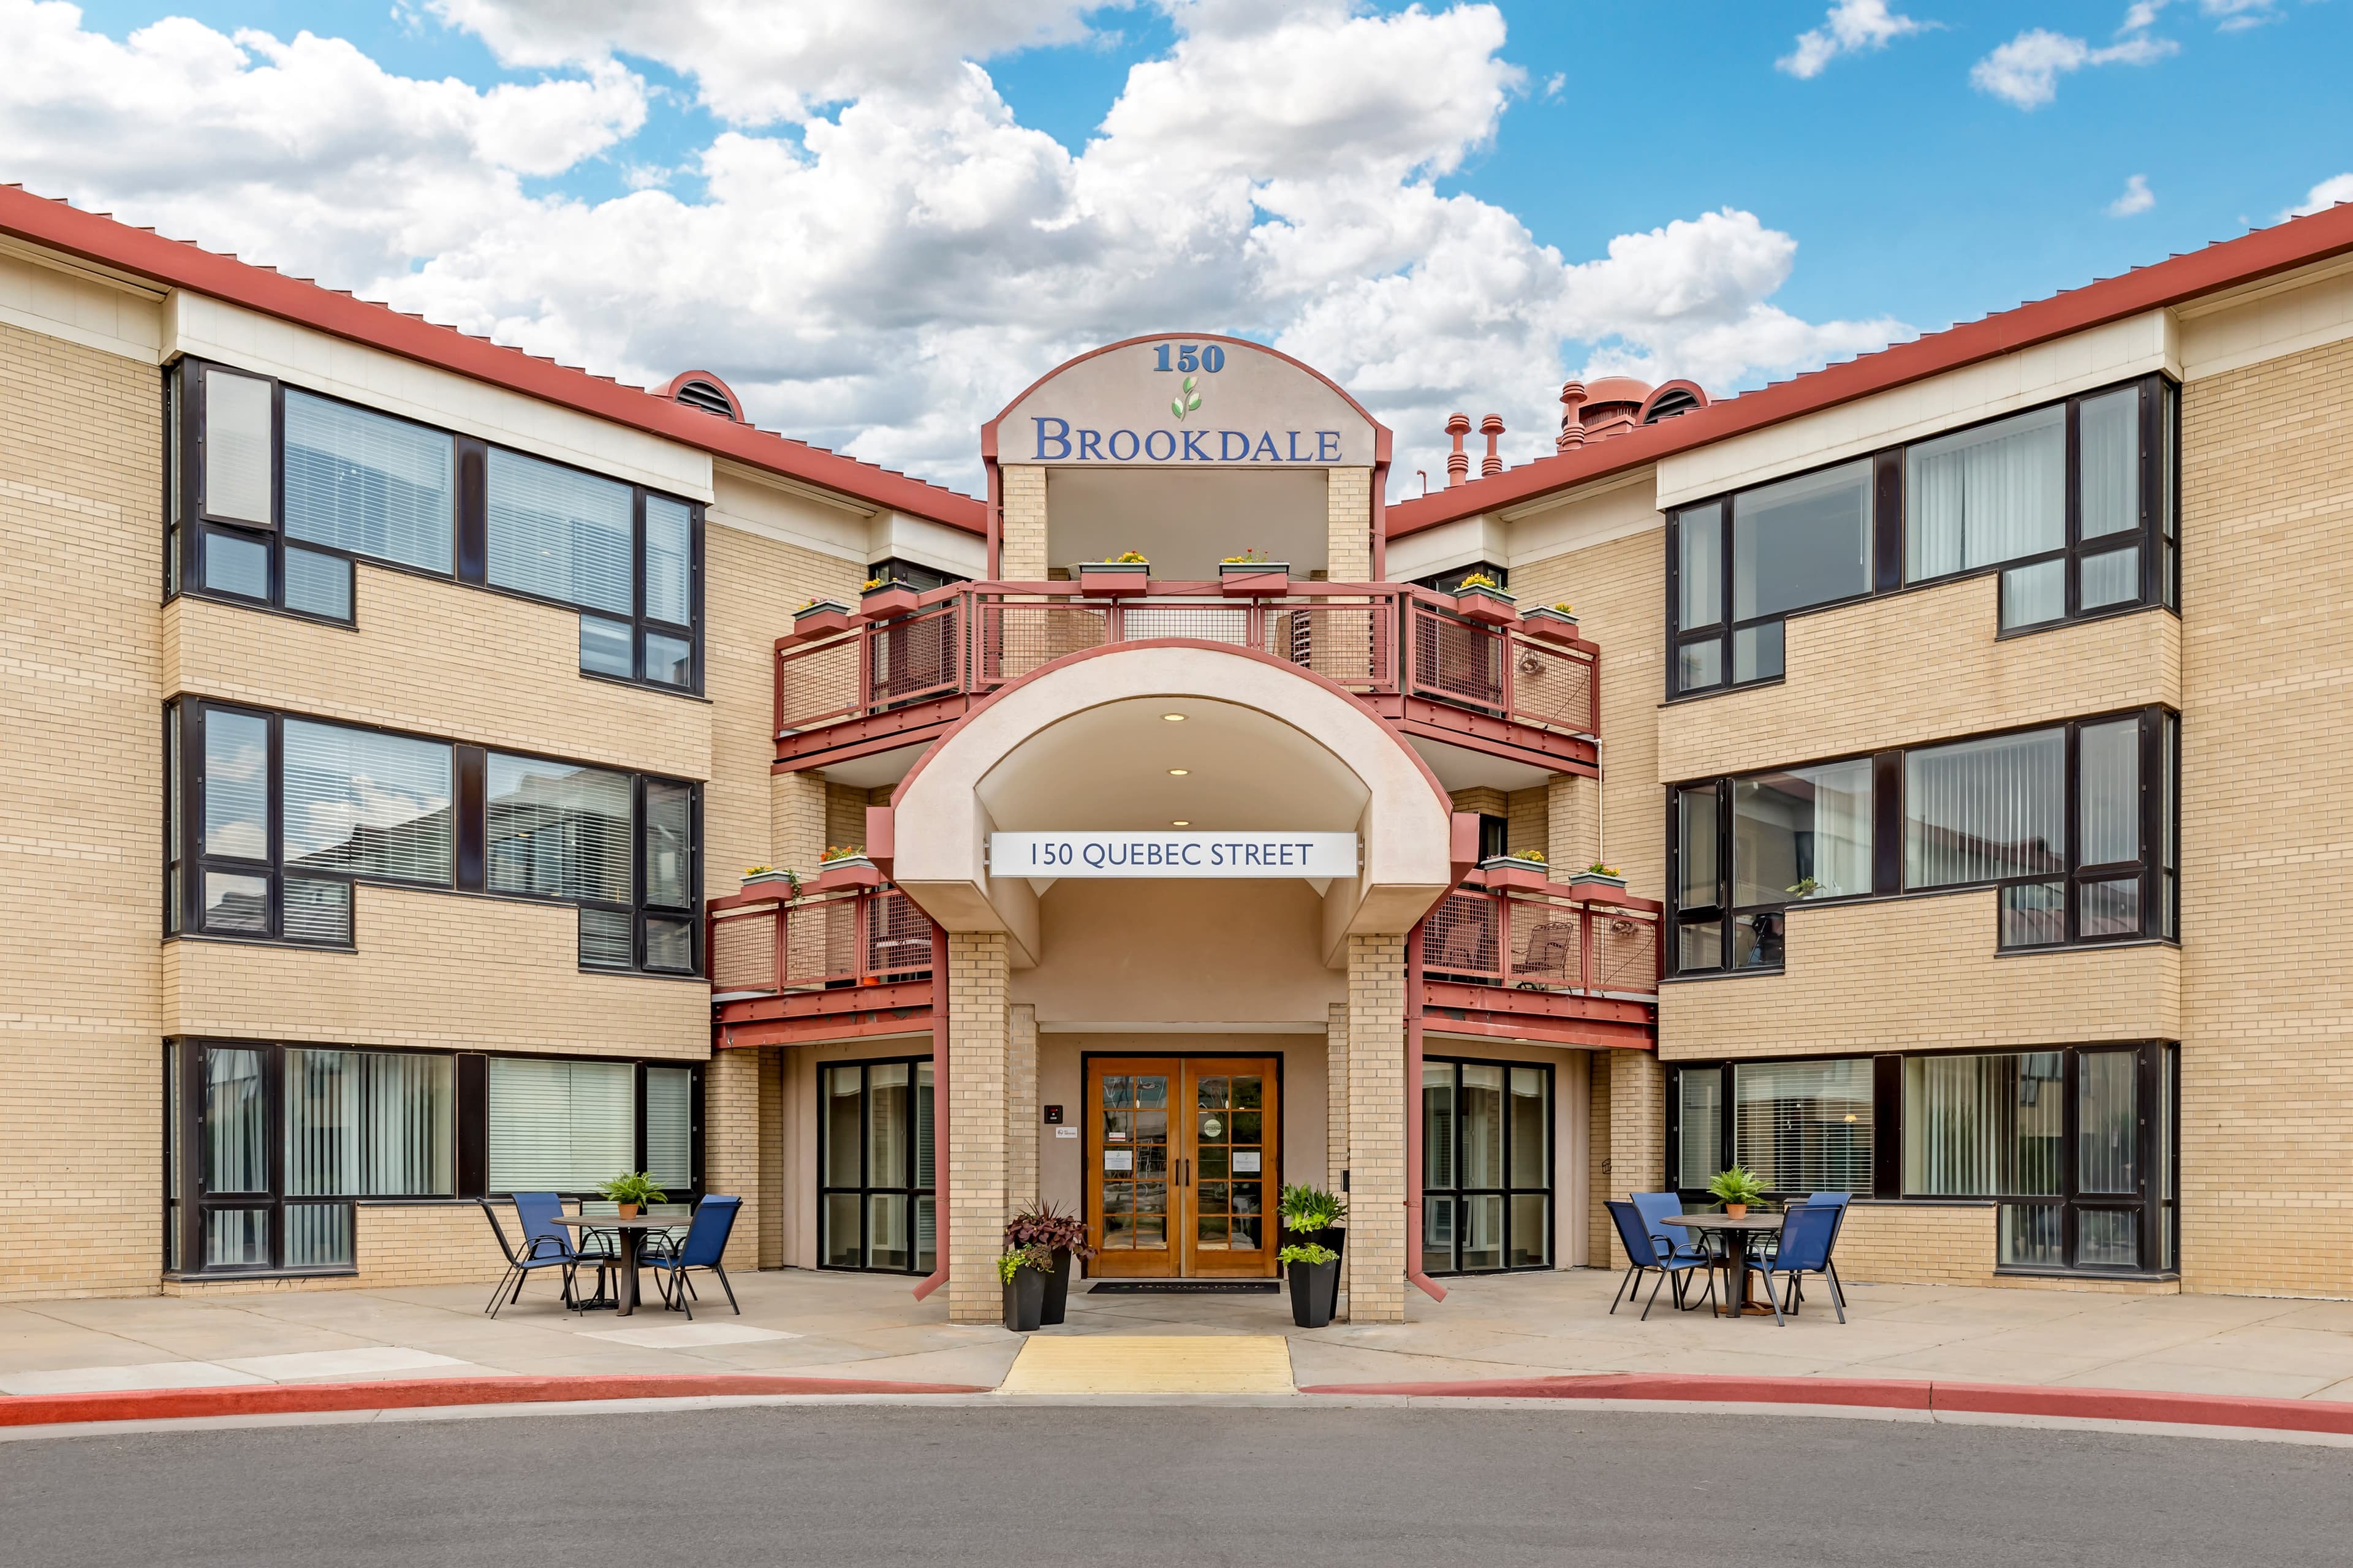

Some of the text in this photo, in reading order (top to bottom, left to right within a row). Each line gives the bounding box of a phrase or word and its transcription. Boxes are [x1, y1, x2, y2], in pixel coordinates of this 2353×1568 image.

[1153, 343, 1225, 373] 150
[1031, 417, 1342, 461] BROOKDALE
[1032, 843, 1313, 869] 150 QUEBEC STREET
